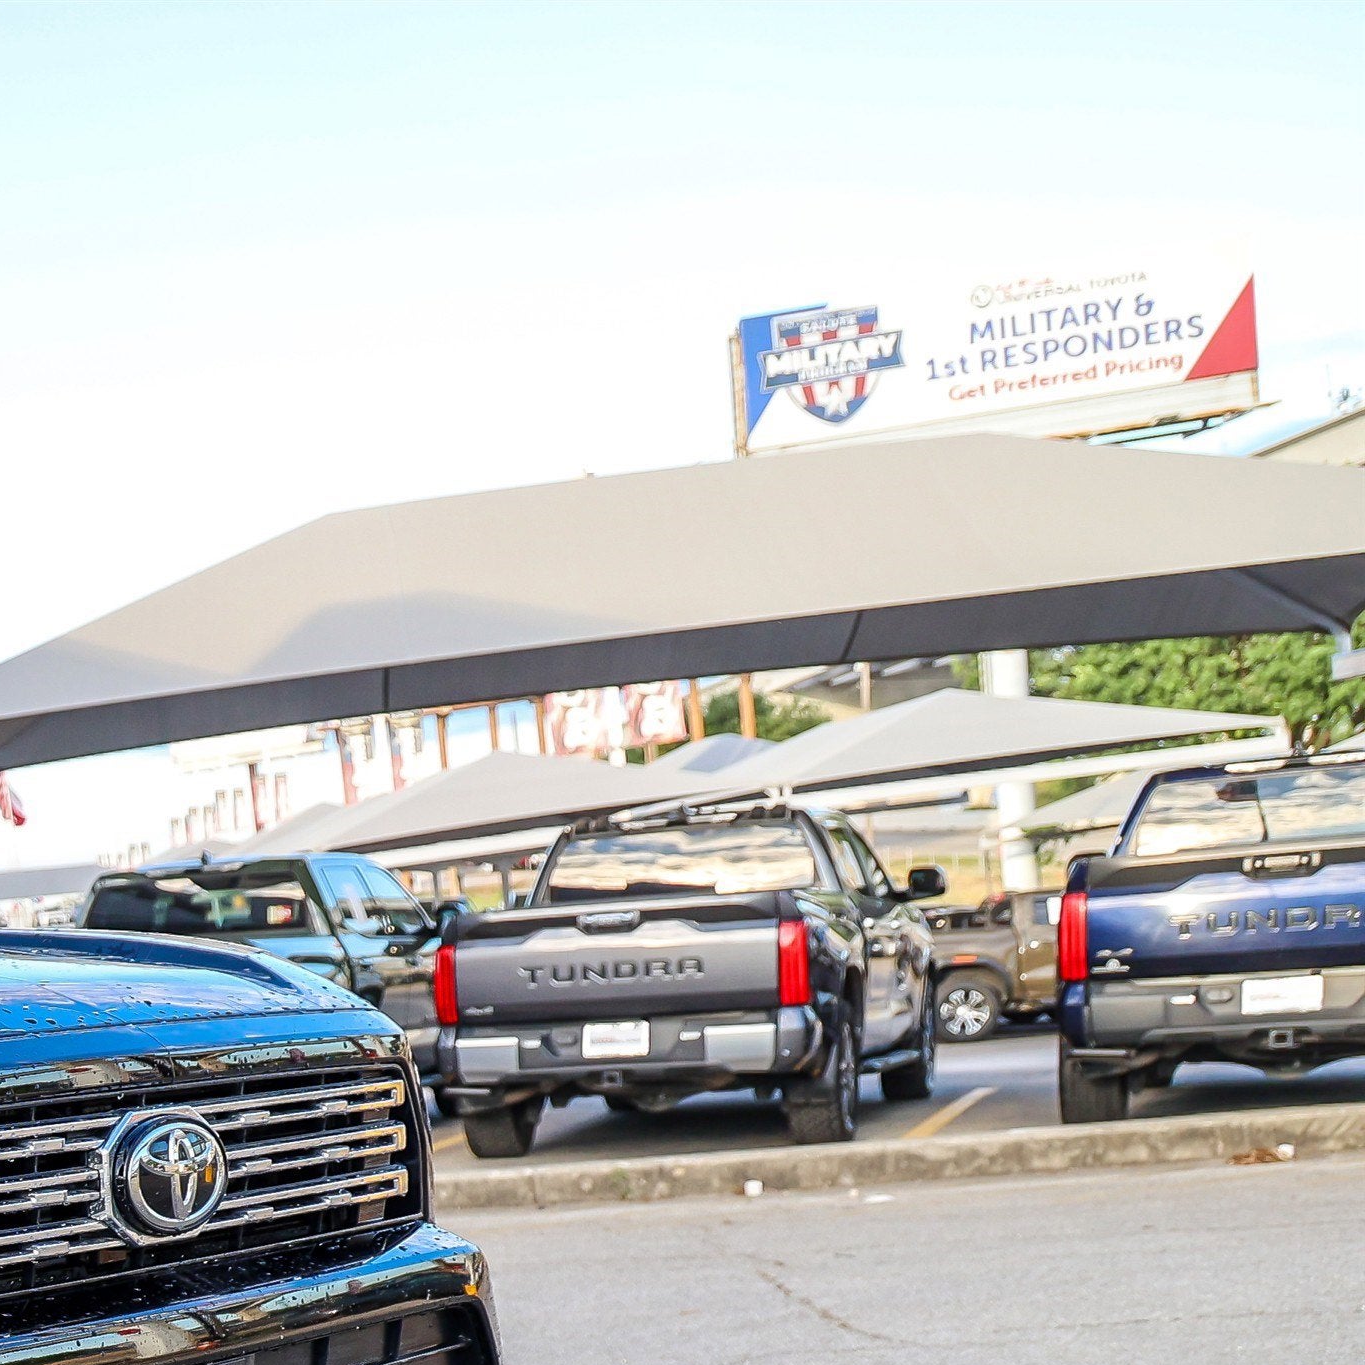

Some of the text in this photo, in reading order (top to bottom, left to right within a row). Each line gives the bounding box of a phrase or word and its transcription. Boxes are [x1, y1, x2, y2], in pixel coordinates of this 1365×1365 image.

[970, 292, 1155, 344] MILITARY &
[926, 314, 1205, 381] 1st RESPONDERS
[948, 353, 1185, 402] Get Preferred Pricing
[1169, 904, 1365, 940] TUNDR
[518, 956, 707, 989] TUNDRA
